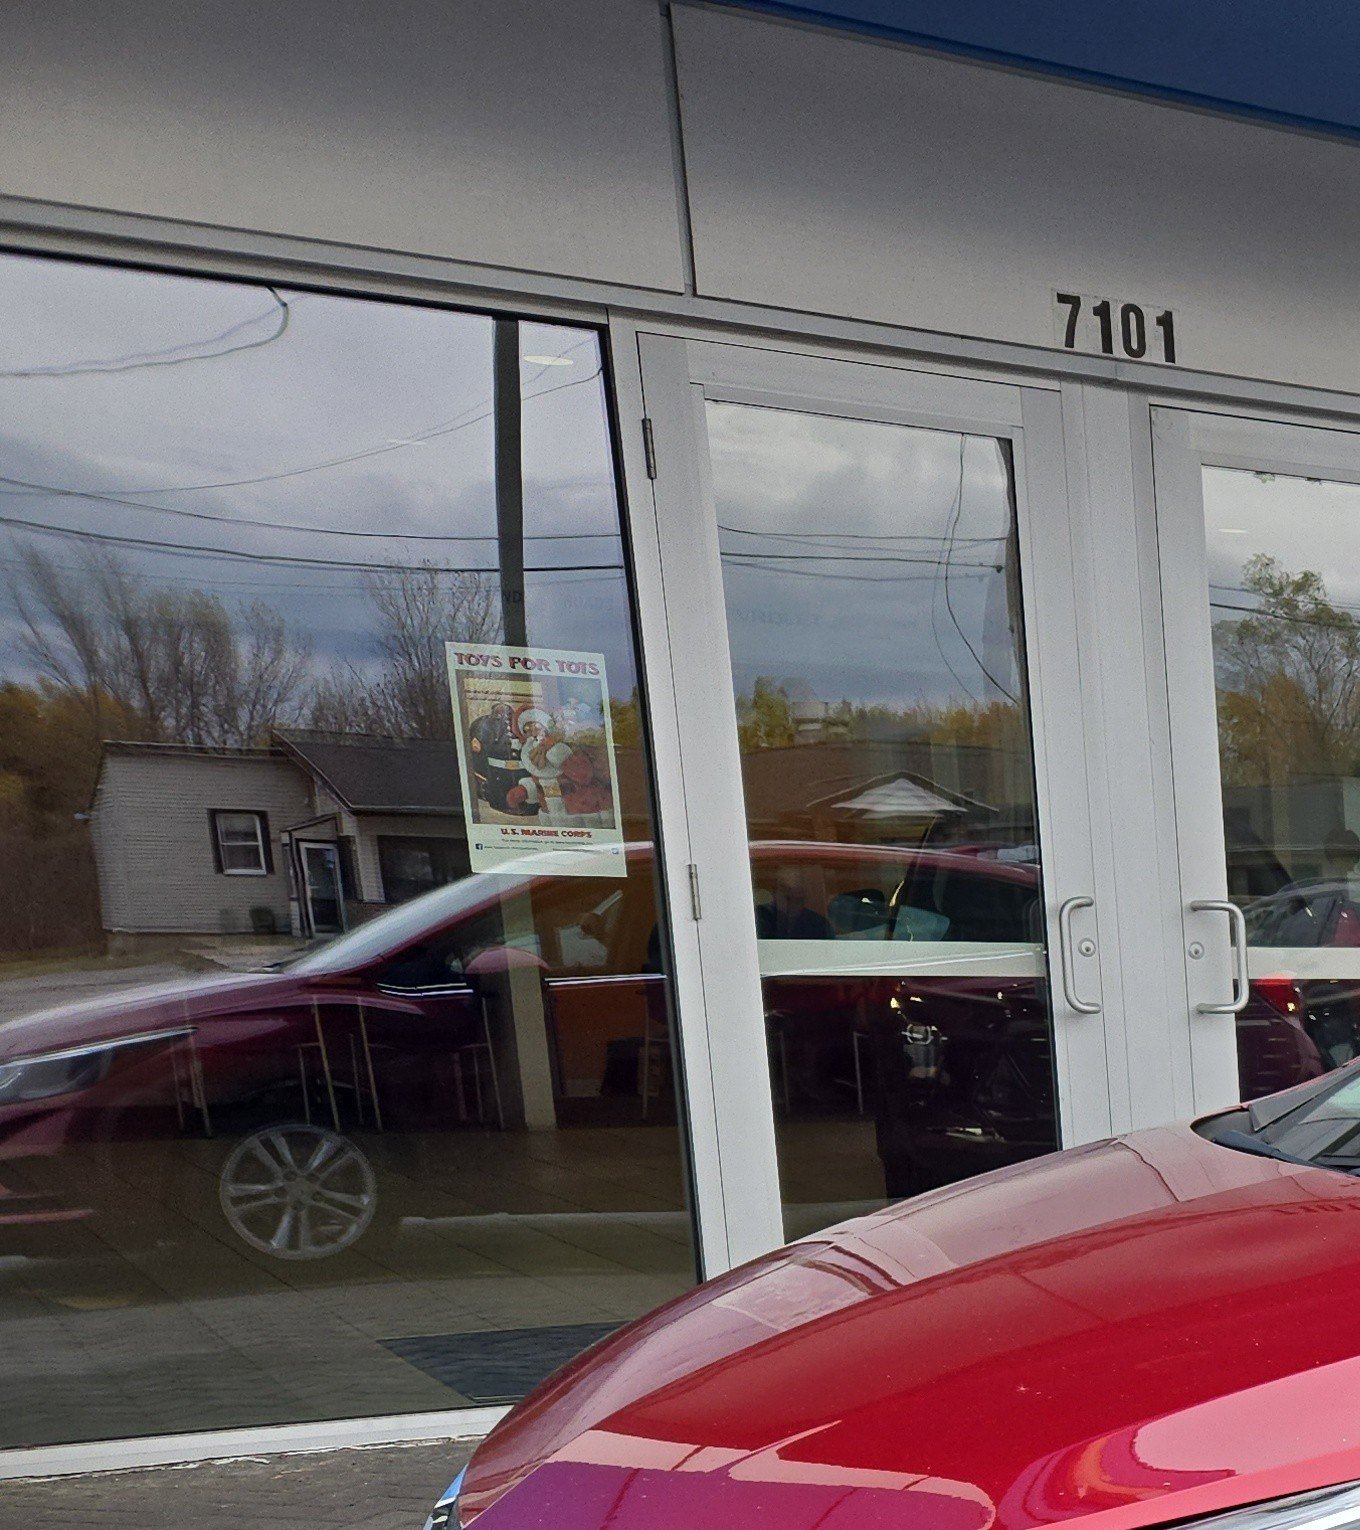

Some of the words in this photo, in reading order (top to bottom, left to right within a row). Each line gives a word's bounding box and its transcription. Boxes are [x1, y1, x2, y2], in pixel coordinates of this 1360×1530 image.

[1056, 292, 1176, 365] 7101
[454, 652, 503, 668] TOYS
[508, 656, 551, 673] FOR
[555, 659, 600, 676] TOTS
